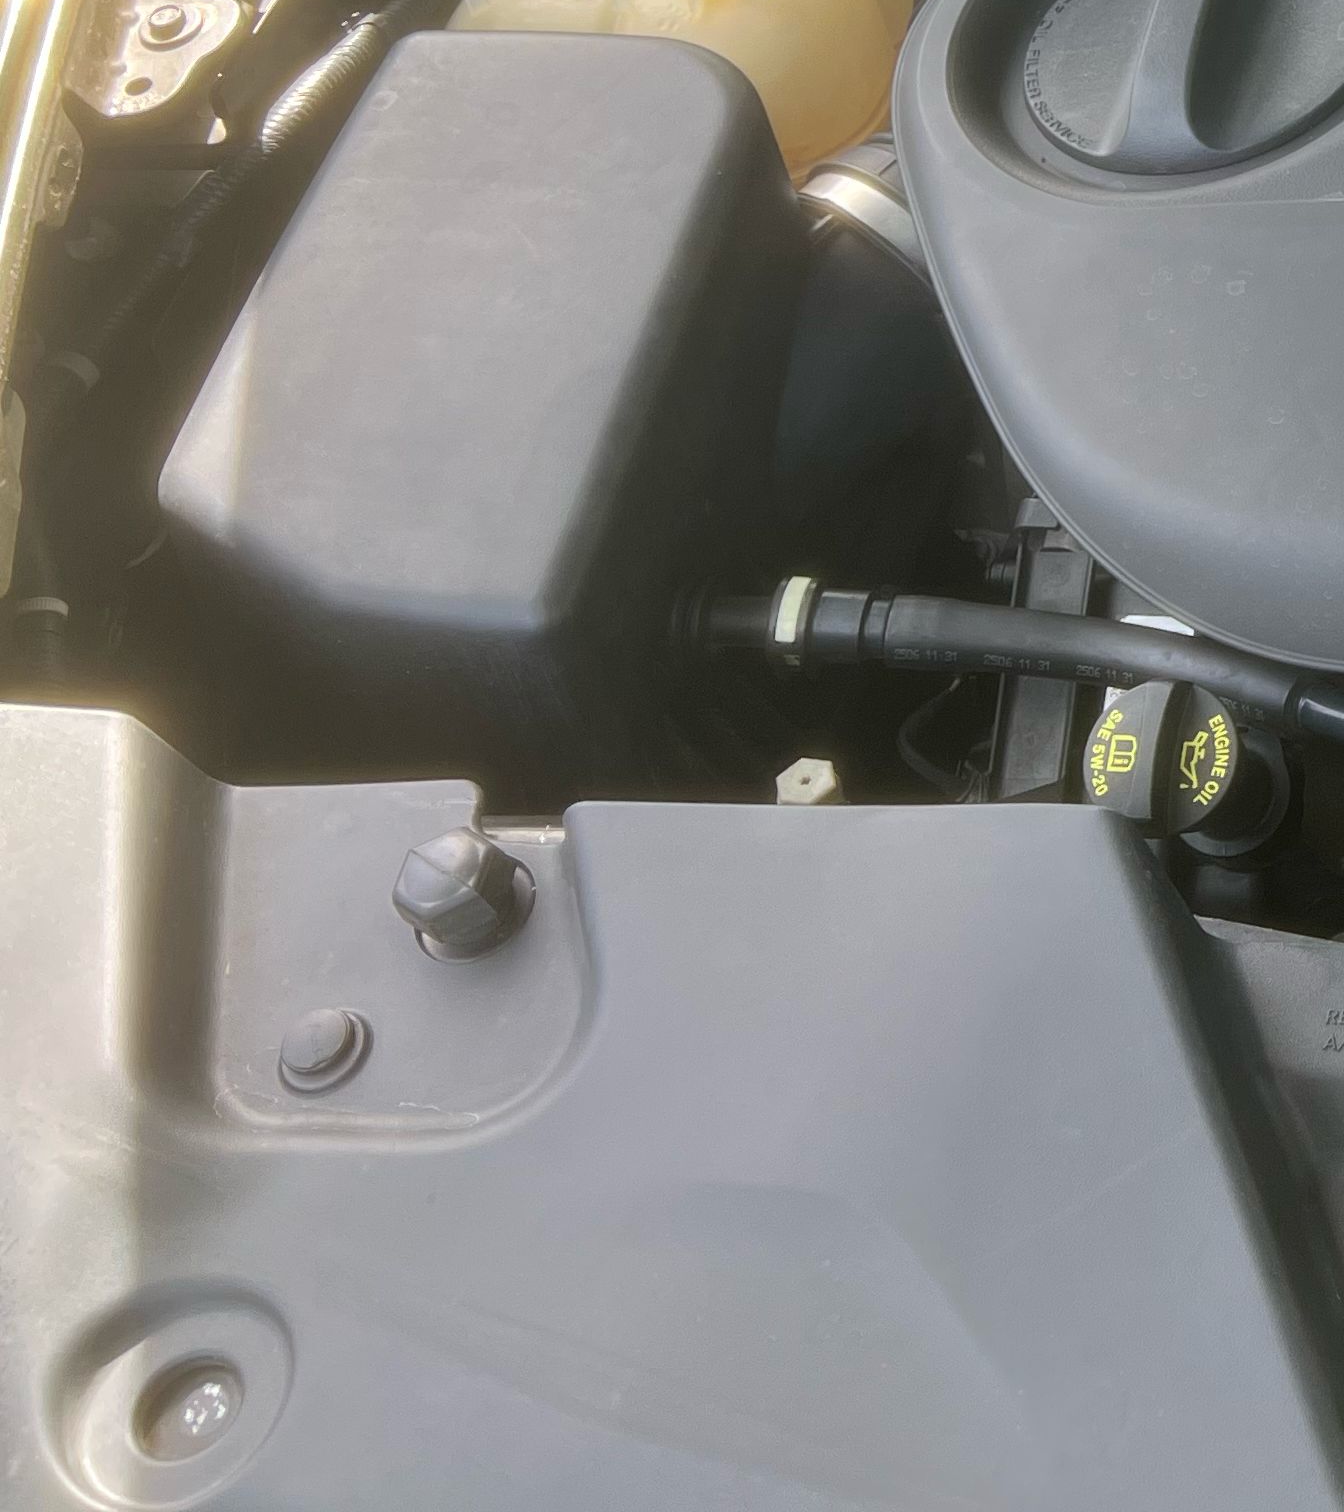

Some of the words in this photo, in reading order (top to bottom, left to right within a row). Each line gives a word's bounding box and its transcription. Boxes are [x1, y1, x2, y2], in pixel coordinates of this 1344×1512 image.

[1032, 19, 1054, 43] OIL
[1025, 49, 1042, 99] FILTER
[1075, 664, 1100, 678] 2506
[1096, 709, 1124, 742] SAE
[1208, 714, 1231, 778] ENGINE
[1089, 743, 1109, 797] 5W-20
[1192, 779, 1220, 806] OIL
